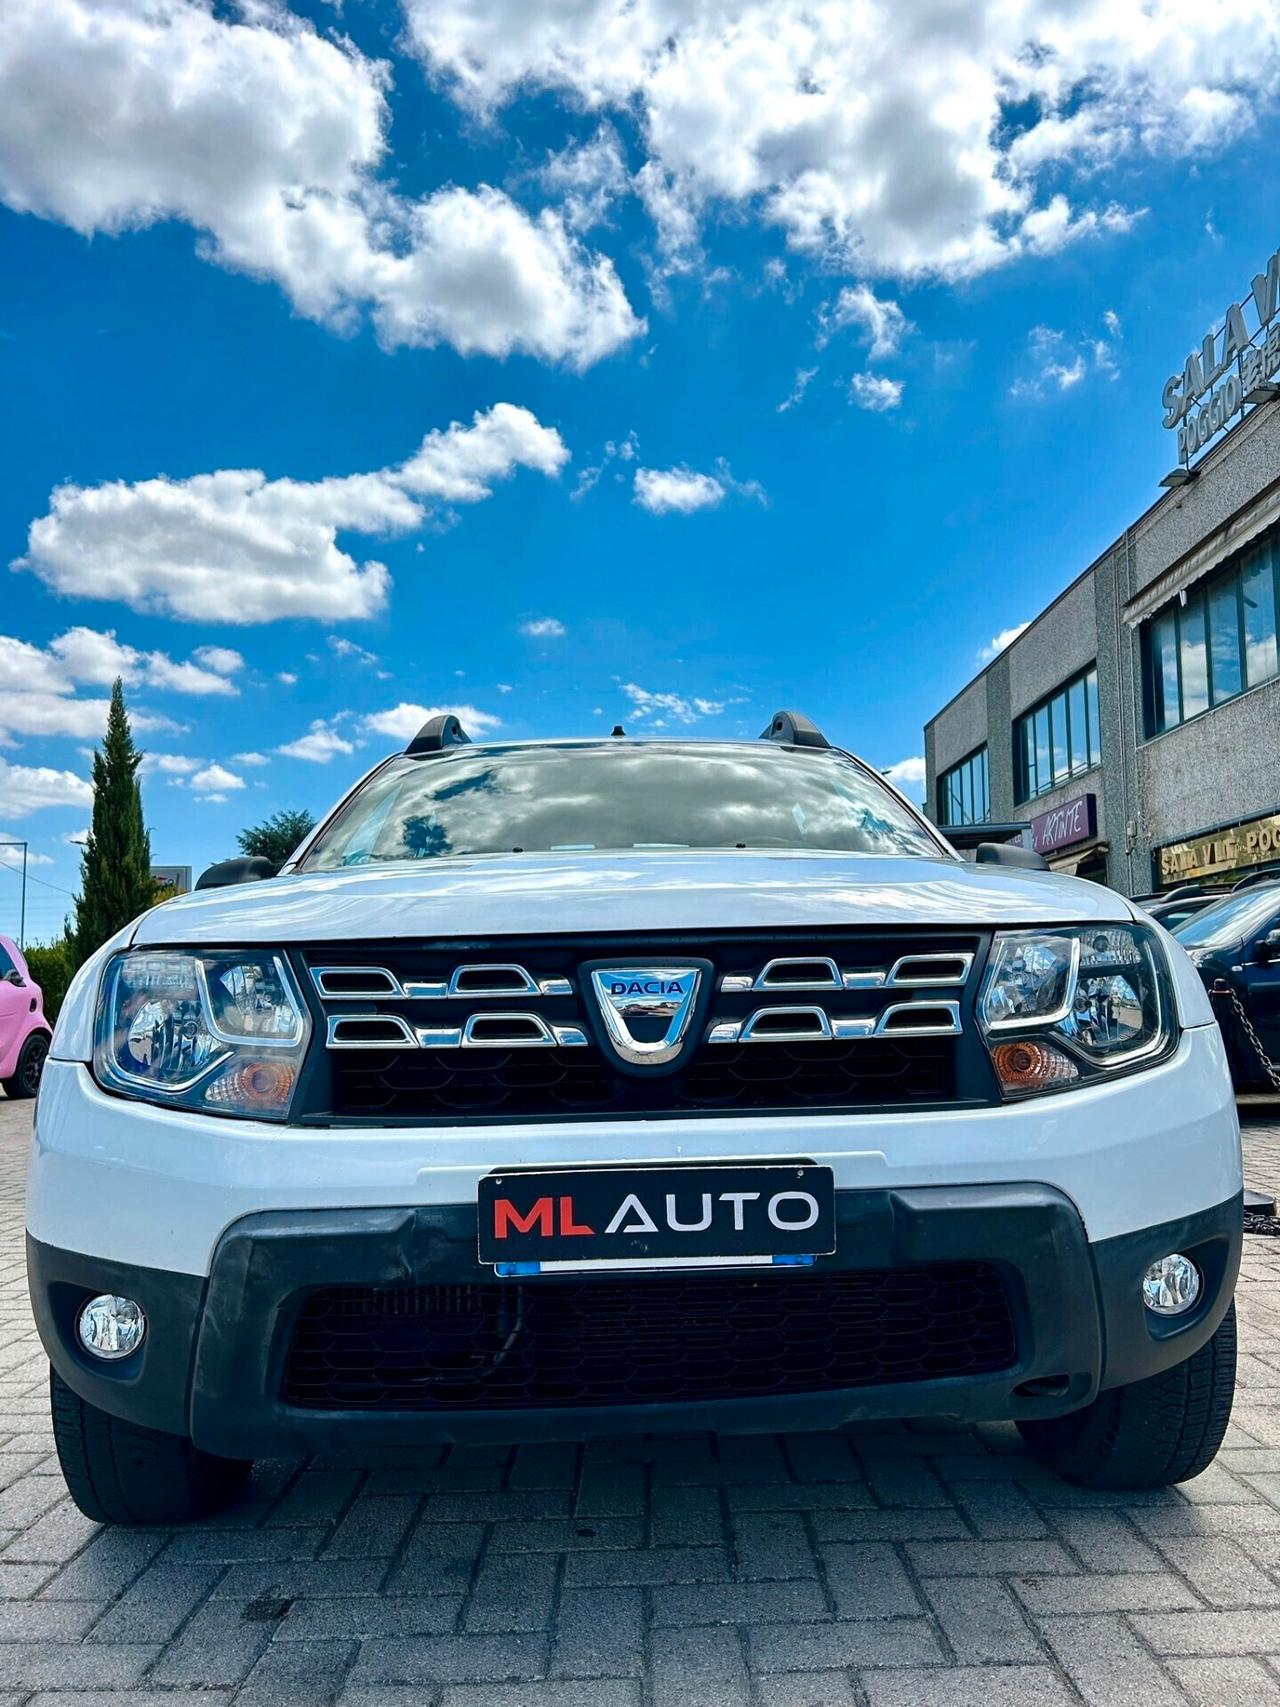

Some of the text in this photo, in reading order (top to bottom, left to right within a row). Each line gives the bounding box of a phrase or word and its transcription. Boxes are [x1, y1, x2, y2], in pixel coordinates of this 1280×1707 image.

[1162, 303, 1250, 429] SALA
[1251, 250, 1280, 327] V
[1177, 374, 1243, 465] POGGIO
[1161, 847, 1199, 876] SALA
[611, 981, 684, 995] DACIA
[494, 1191, 820, 1239] ML AUTO
